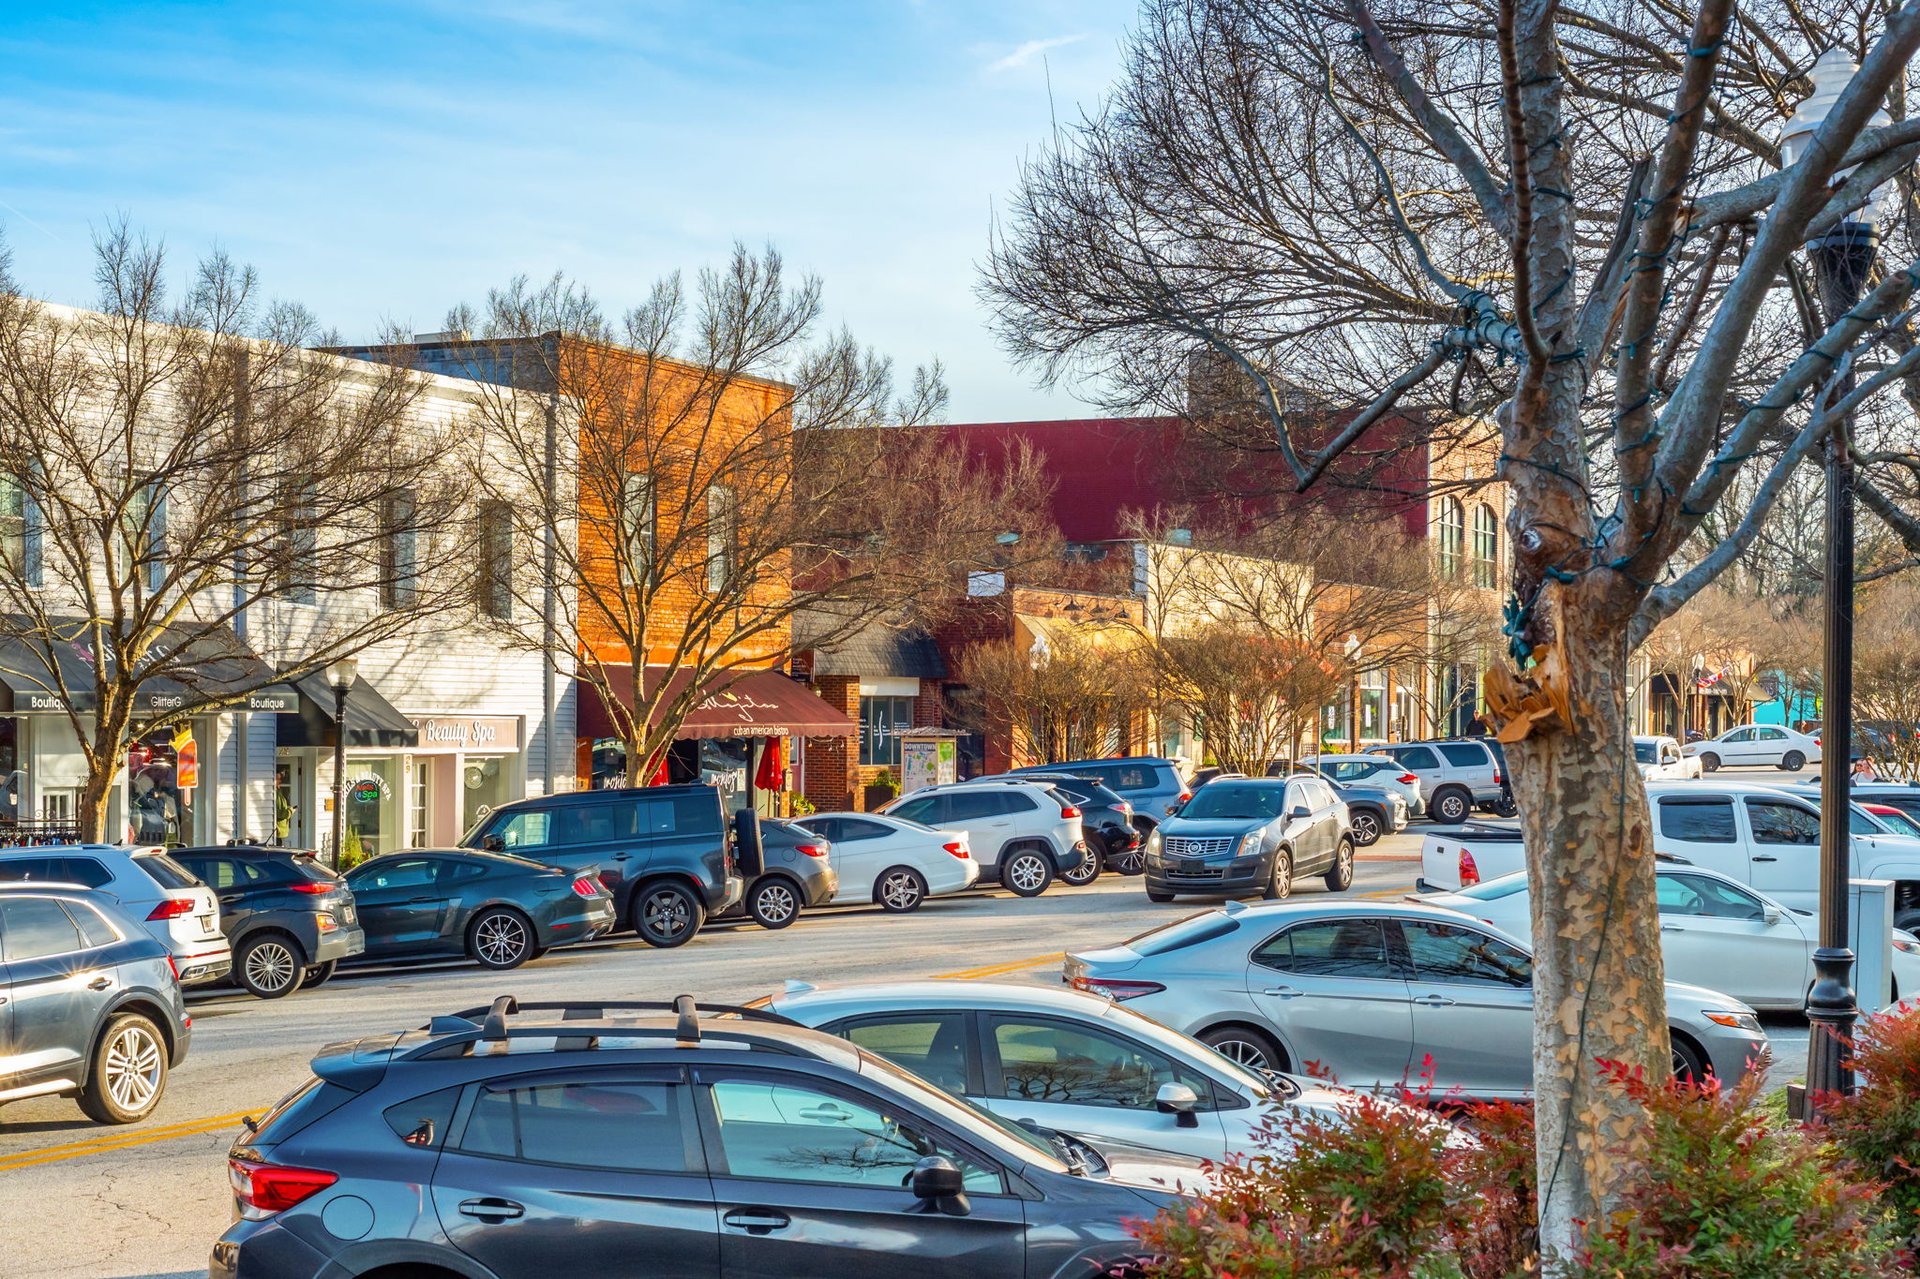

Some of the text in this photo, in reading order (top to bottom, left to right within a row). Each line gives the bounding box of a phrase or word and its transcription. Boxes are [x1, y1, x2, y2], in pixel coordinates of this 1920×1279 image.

[250, 697, 285, 709] Boutique
[425, 719, 468, 748] Beauty
[471, 719, 496, 748] Spa
[733, 725, 789, 736] cuban american bistro
[362, 790, 378, 800] Spa
